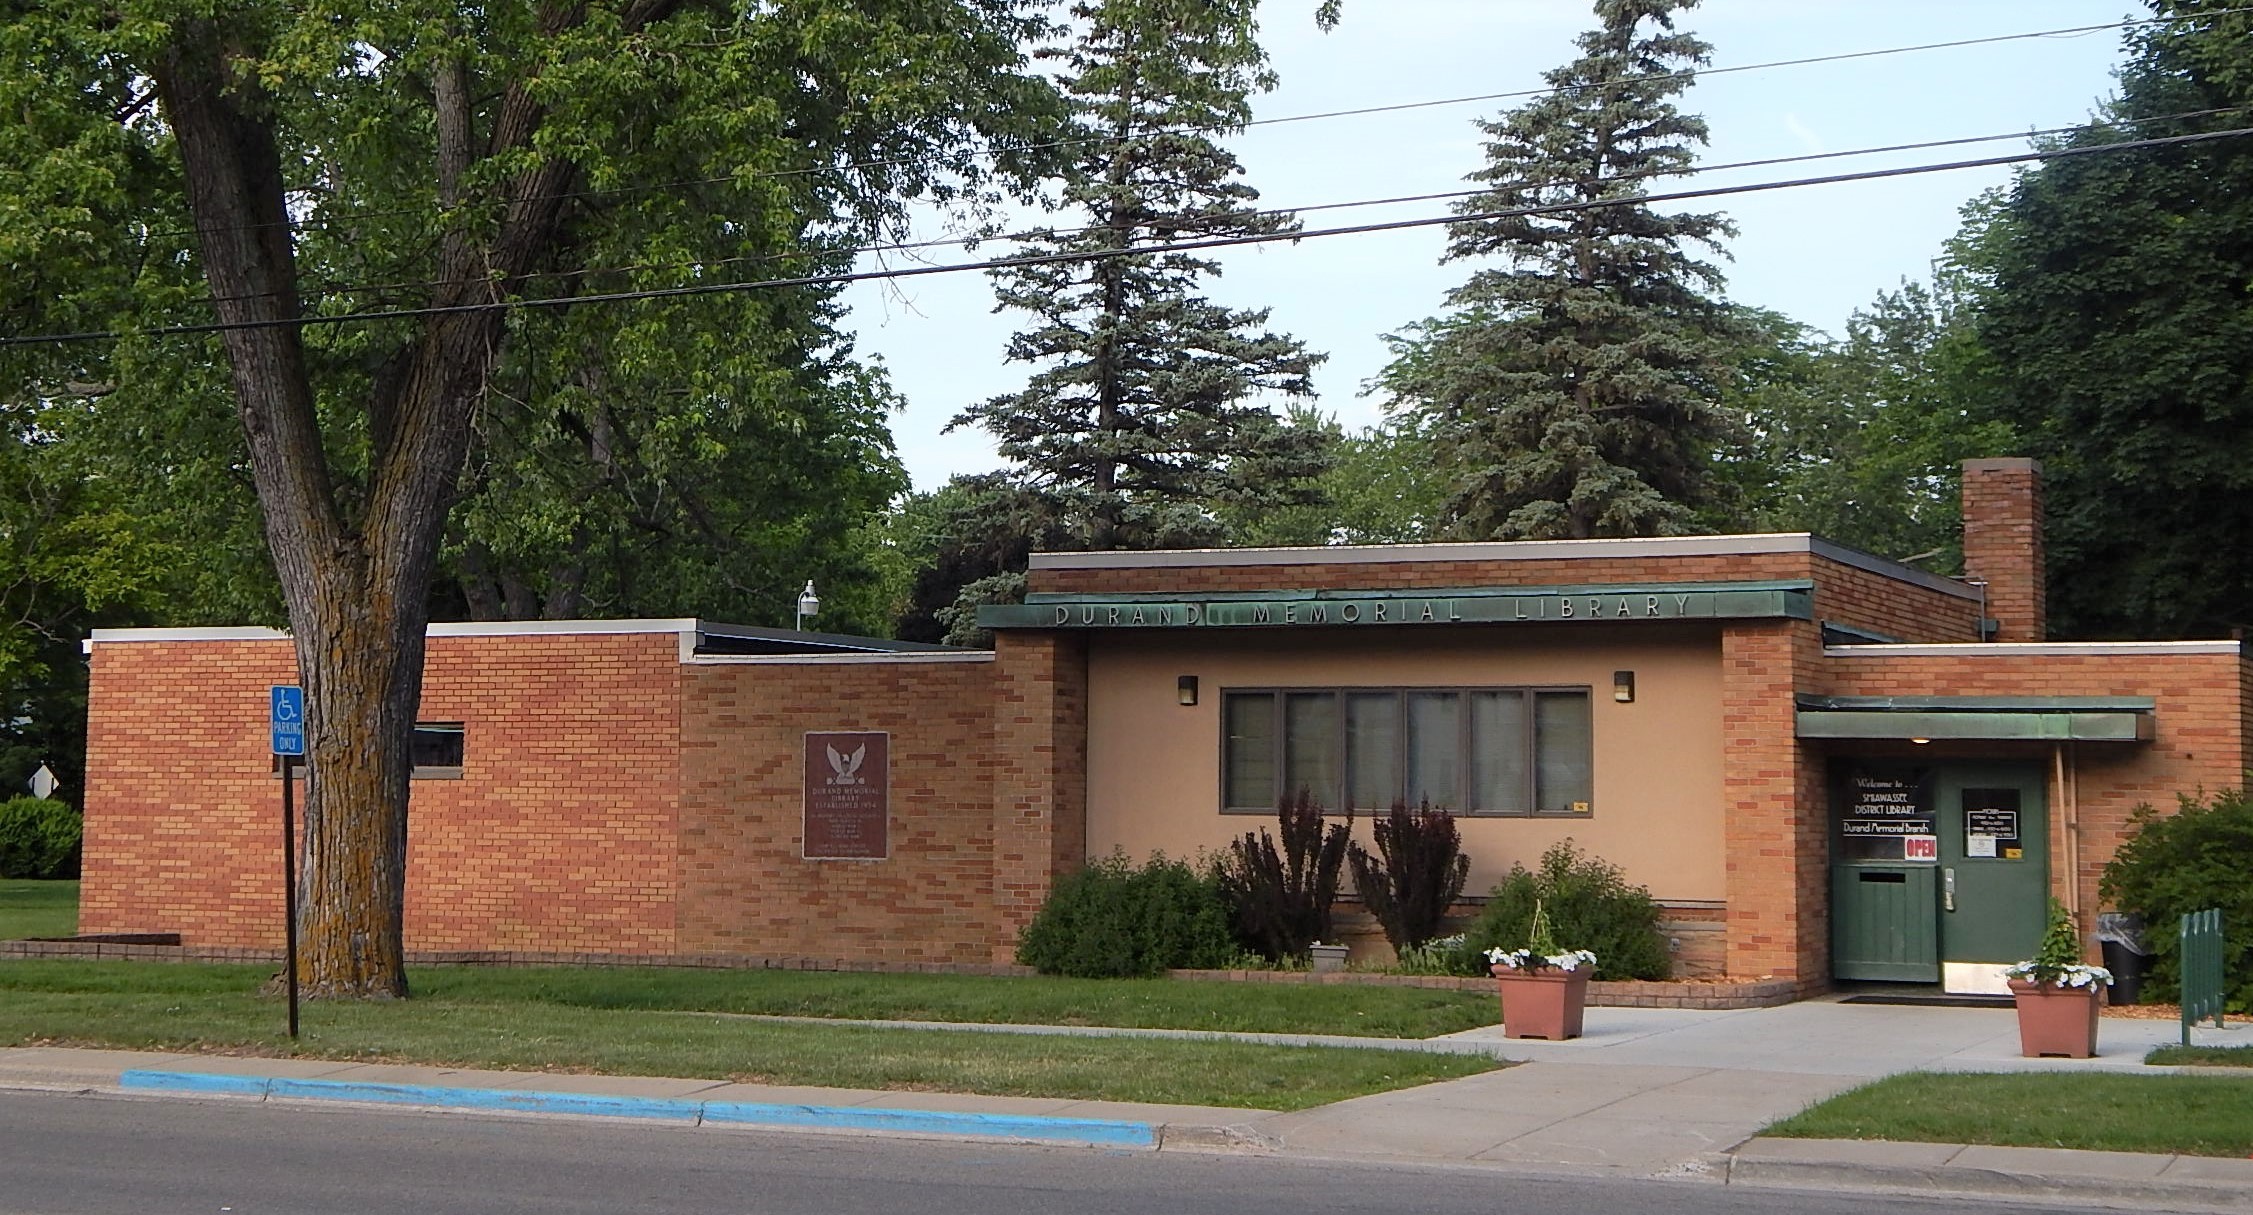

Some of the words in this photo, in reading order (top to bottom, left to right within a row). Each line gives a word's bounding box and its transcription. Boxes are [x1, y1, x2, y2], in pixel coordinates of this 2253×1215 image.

[1055, 602, 1200, 625] DURAND
[1253, 599, 1461, 624] MEMORIAL
[1515, 595, 1689, 618] LIBRARY
[273, 721, 302, 735] PARKING
[279, 736, 297, 750] ONLY
[1856, 778, 1892, 788] Welcome
[1854, 804, 1884, 815] DISTRICT
[1886, 805, 1916, 815] LIBRARY
[1843, 822, 1870, 833] Durand
[1871, 822, 1905, 833] Memorial
[1905, 823, 1929, 833] Branch
[1906, 838, 1936, 858] OPEN
